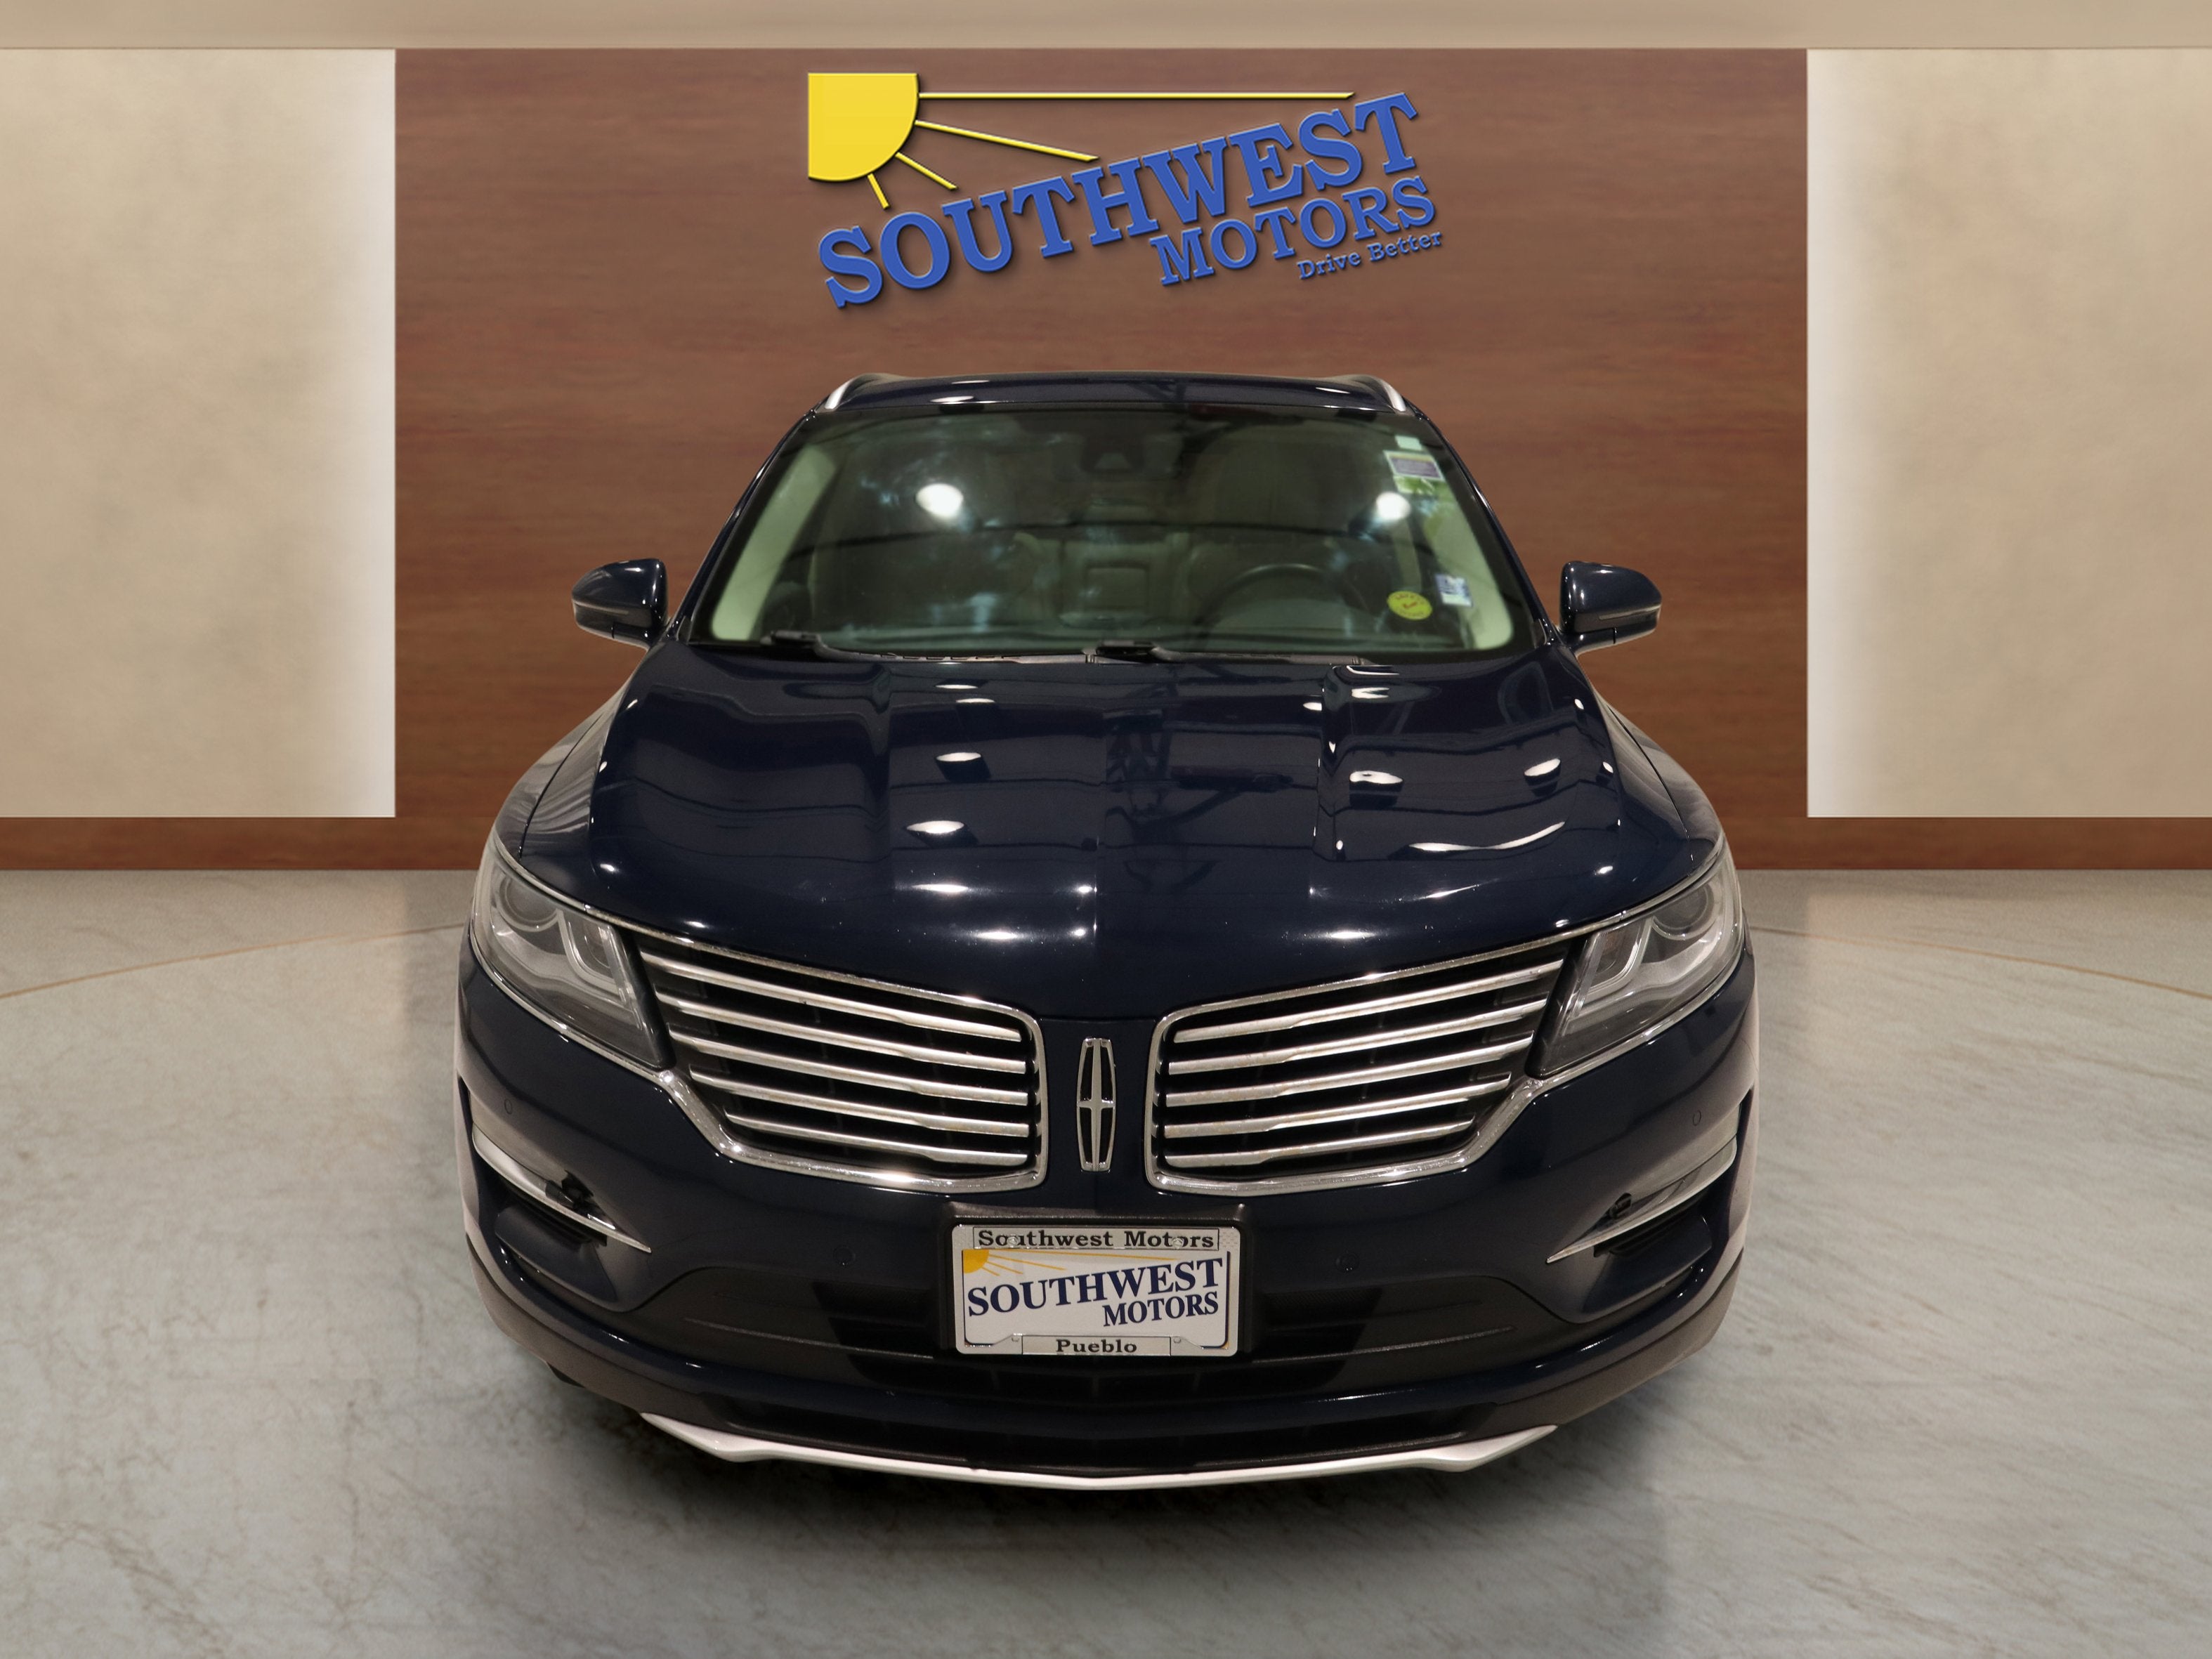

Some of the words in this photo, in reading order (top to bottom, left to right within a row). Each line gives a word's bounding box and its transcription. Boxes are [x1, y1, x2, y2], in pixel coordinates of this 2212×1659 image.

[818, 93, 1418, 308] SOUTHWEST
[1151, 177, 1436, 286] MOTORS
[1297, 243, 1361, 280] Drive
[1367, 230, 1443, 262] Better
[968, 1258, 1223, 1317] SOUTHWEST
[1103, 1292, 1219, 1327] MOTORS
[1056, 1339, 1137, 1353] Pueblo
